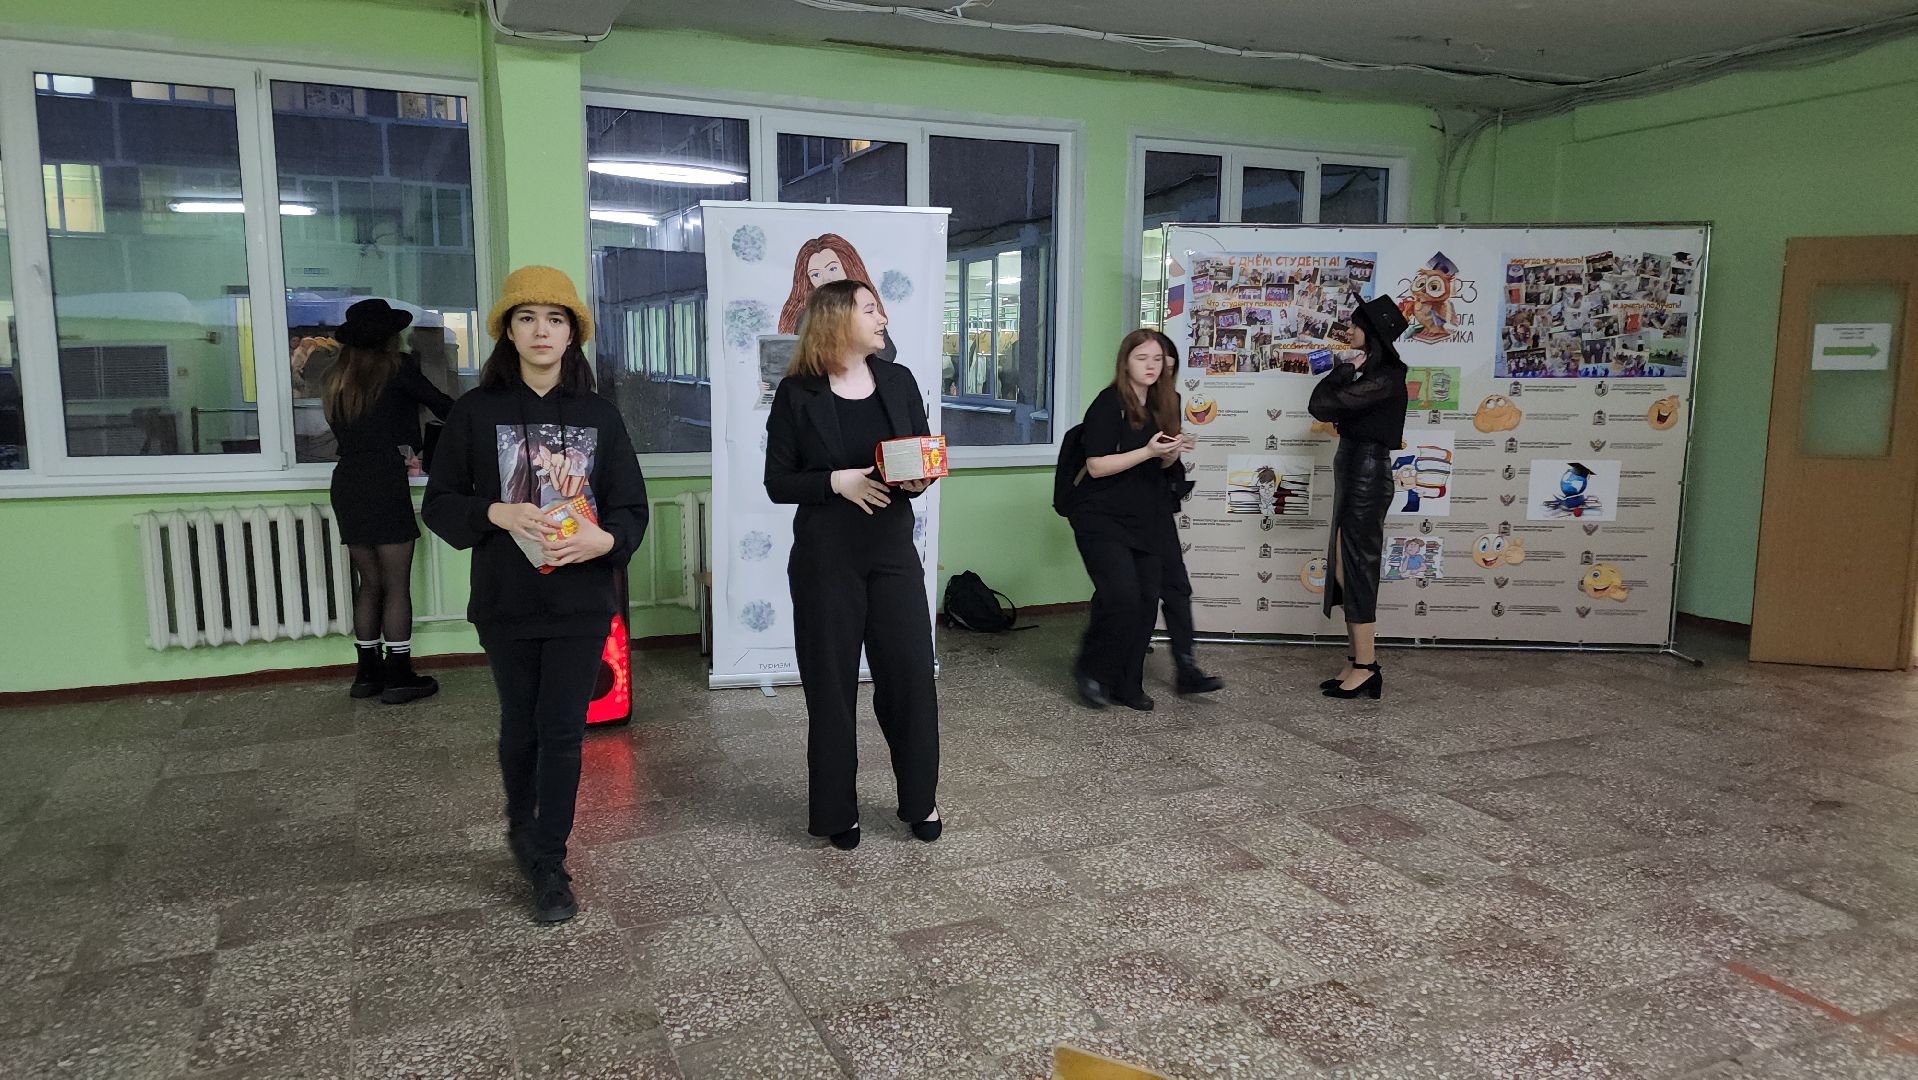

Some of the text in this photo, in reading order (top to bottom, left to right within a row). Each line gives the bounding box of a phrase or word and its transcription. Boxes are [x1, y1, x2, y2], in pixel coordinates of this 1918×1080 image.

[1228, 254, 1340, 267] С ДНЁМ СТУДЕНТА!
